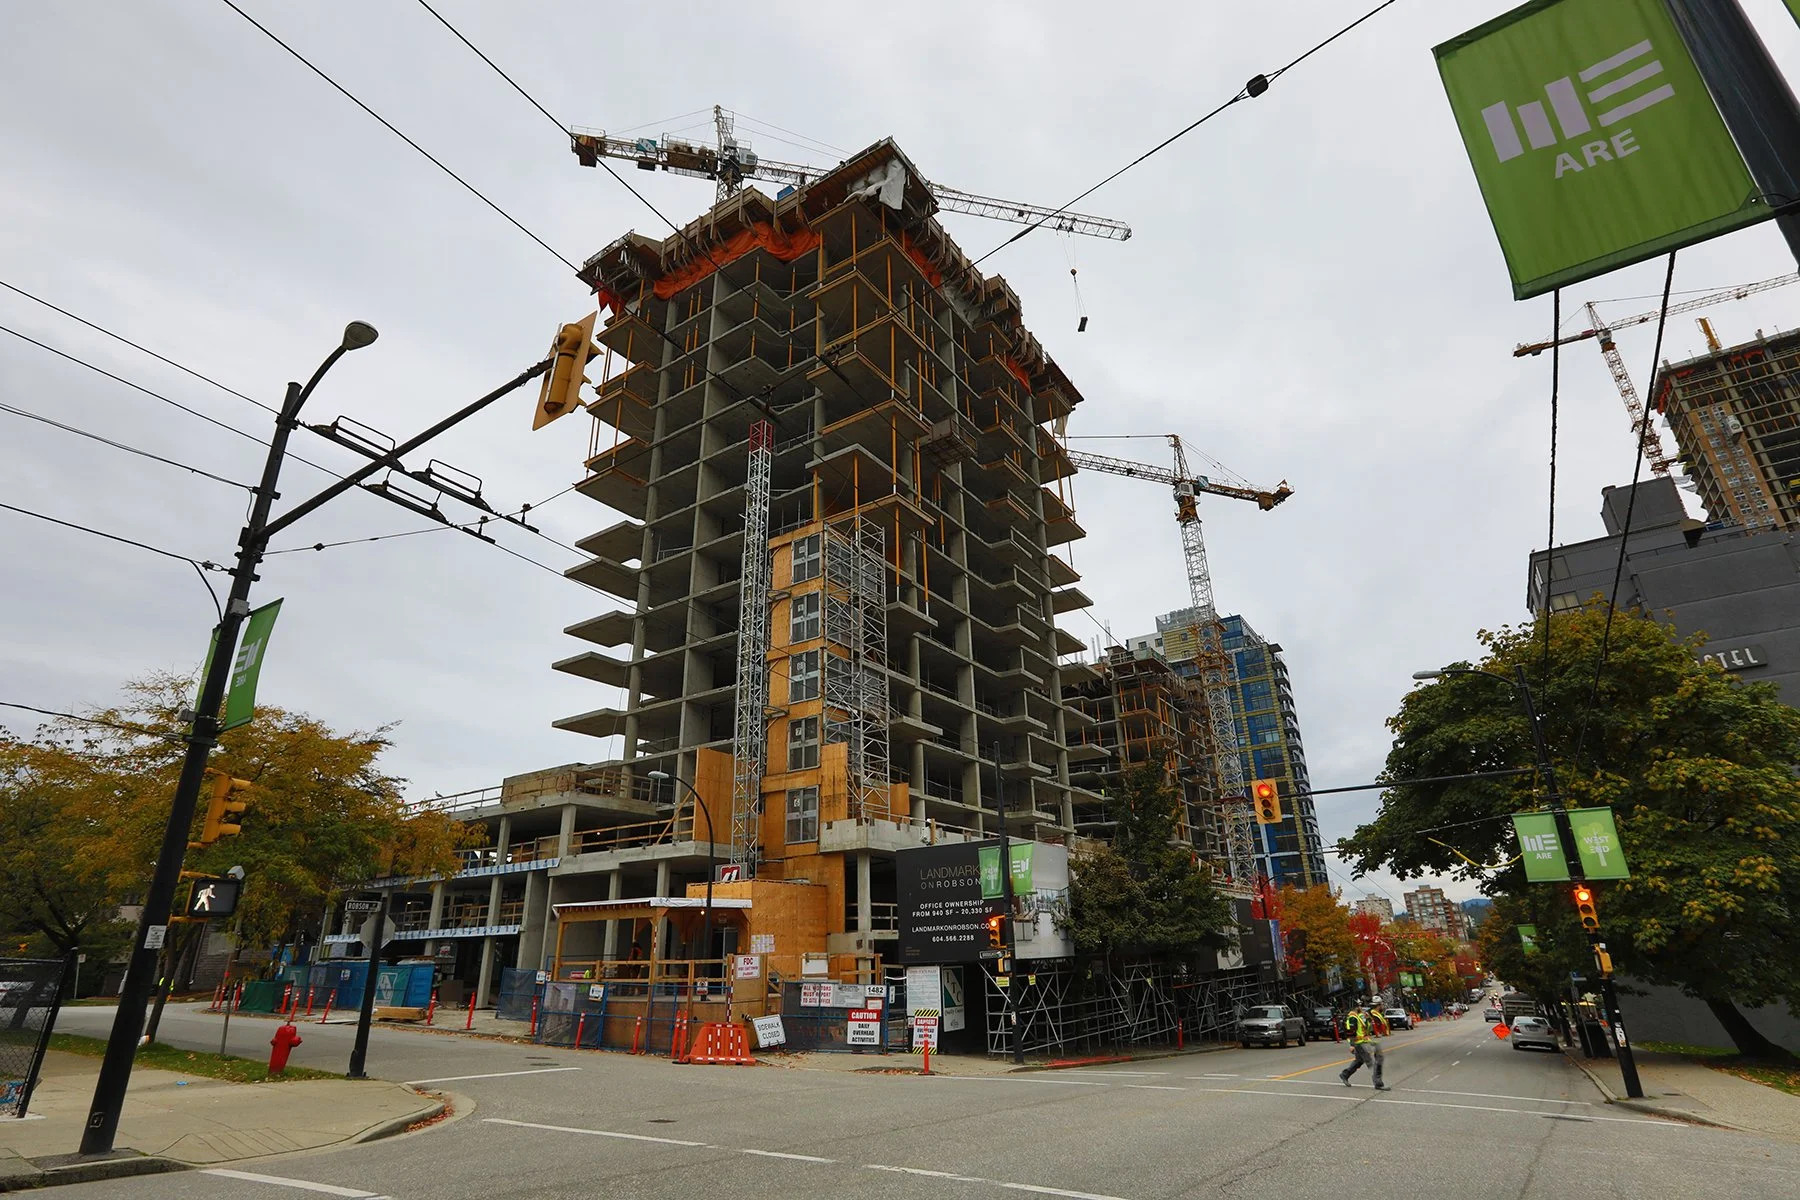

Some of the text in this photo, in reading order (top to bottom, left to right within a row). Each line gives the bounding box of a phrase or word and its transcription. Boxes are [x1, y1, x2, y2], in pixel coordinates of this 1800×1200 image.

[1555, 128, 1641, 179] ARE
[1583, 835, 1610, 844] WEST
[1536, 852, 1553, 860] ARE
[920, 865, 981, 880] LANDMARK
[347, 902, 370, 910] ROBSON
[944, 900, 984, 908] OWNERSHIP
[932, 909, 944, 917] 940
[984, 906, 993, 914] SF
[911, 923, 990, 933] LANDMARKONROBSON.CO
[931, 934, 975, 943] 604.566.2288
[743, 957, 754, 966] FDC
[867, 986, 884, 994] 1482
[851, 1012, 878, 1020] CAUTION
[757, 1021, 781, 1033] SIDEWALK
[762, 1031, 781, 1040] CLOSED
